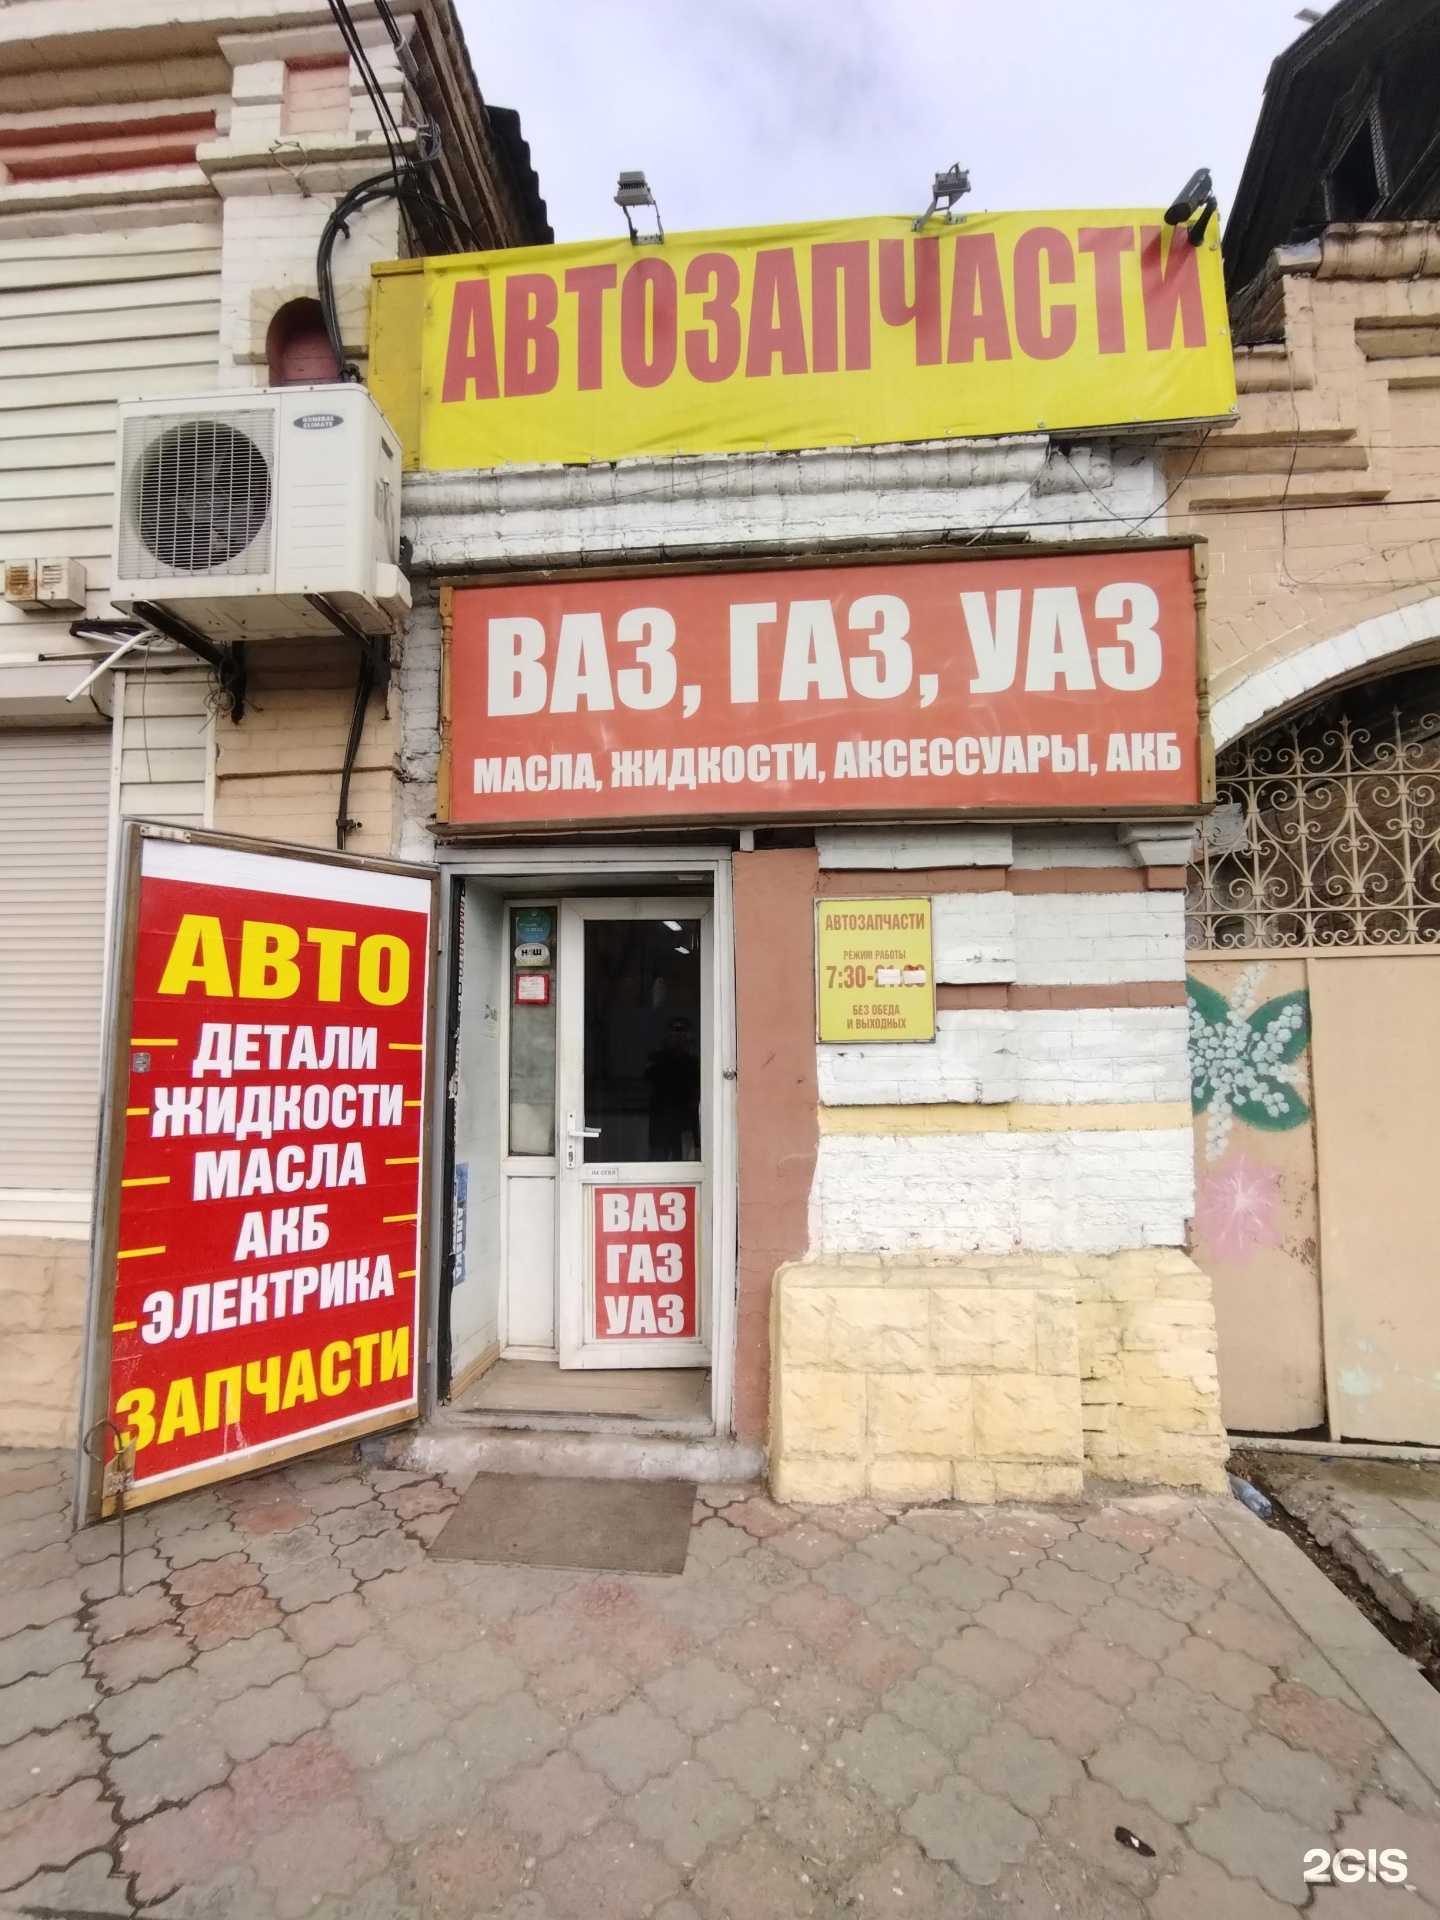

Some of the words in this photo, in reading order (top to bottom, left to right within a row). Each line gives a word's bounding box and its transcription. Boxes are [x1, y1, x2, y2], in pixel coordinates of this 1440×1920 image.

[441, 225, 1207, 403] АВТОЗАПЧАСТИ
[487, 606, 701, 718] ВАЗ,
[730, 594, 939, 708] ГАЗ,
[960, 582, 1162, 694] УАЗ
[473, 753, 603, 793] МАСЛА,
[611, 742, 825, 791] ЖИДКОСТИ,
[833, 733, 1098, 779] АКСЕССУАРЫ,
[1106, 732, 1182, 772] АКБ
[824, 913, 925, 931] АВТОЗАПЧАСТИ
[157, 913, 411, 1007] АВТО
[521, 948, 542, 956] НШ
[843, 950, 873, 960] РЕЖИМ
[875, 949, 906, 960] РАБОТЫ
[847, 1019, 854, 1029] И
[856, 1018, 906, 1030] ВЫХОДНЫХ
[852, 1004, 870, 1016] БЕЗ
[872, 1004, 900, 1016] ОБЕДА
[192, 1022, 378, 1079] ДЕТАЛИ
[151, 1084, 404, 1141] ЖИДКОСТИ
[192, 1142, 367, 1202] МАСЛА
[233, 1203, 330, 1262] АКБ
[602, 1191, 687, 1232] ВАЗ
[606, 1243, 683, 1284] ГАЗ
[141, 1254, 395, 1345] ЭЛЕКТРИКА
[604, 1294, 685, 1334] УАЗ
[113, 1326, 410, 1453] ЗАПЧАСТИ
